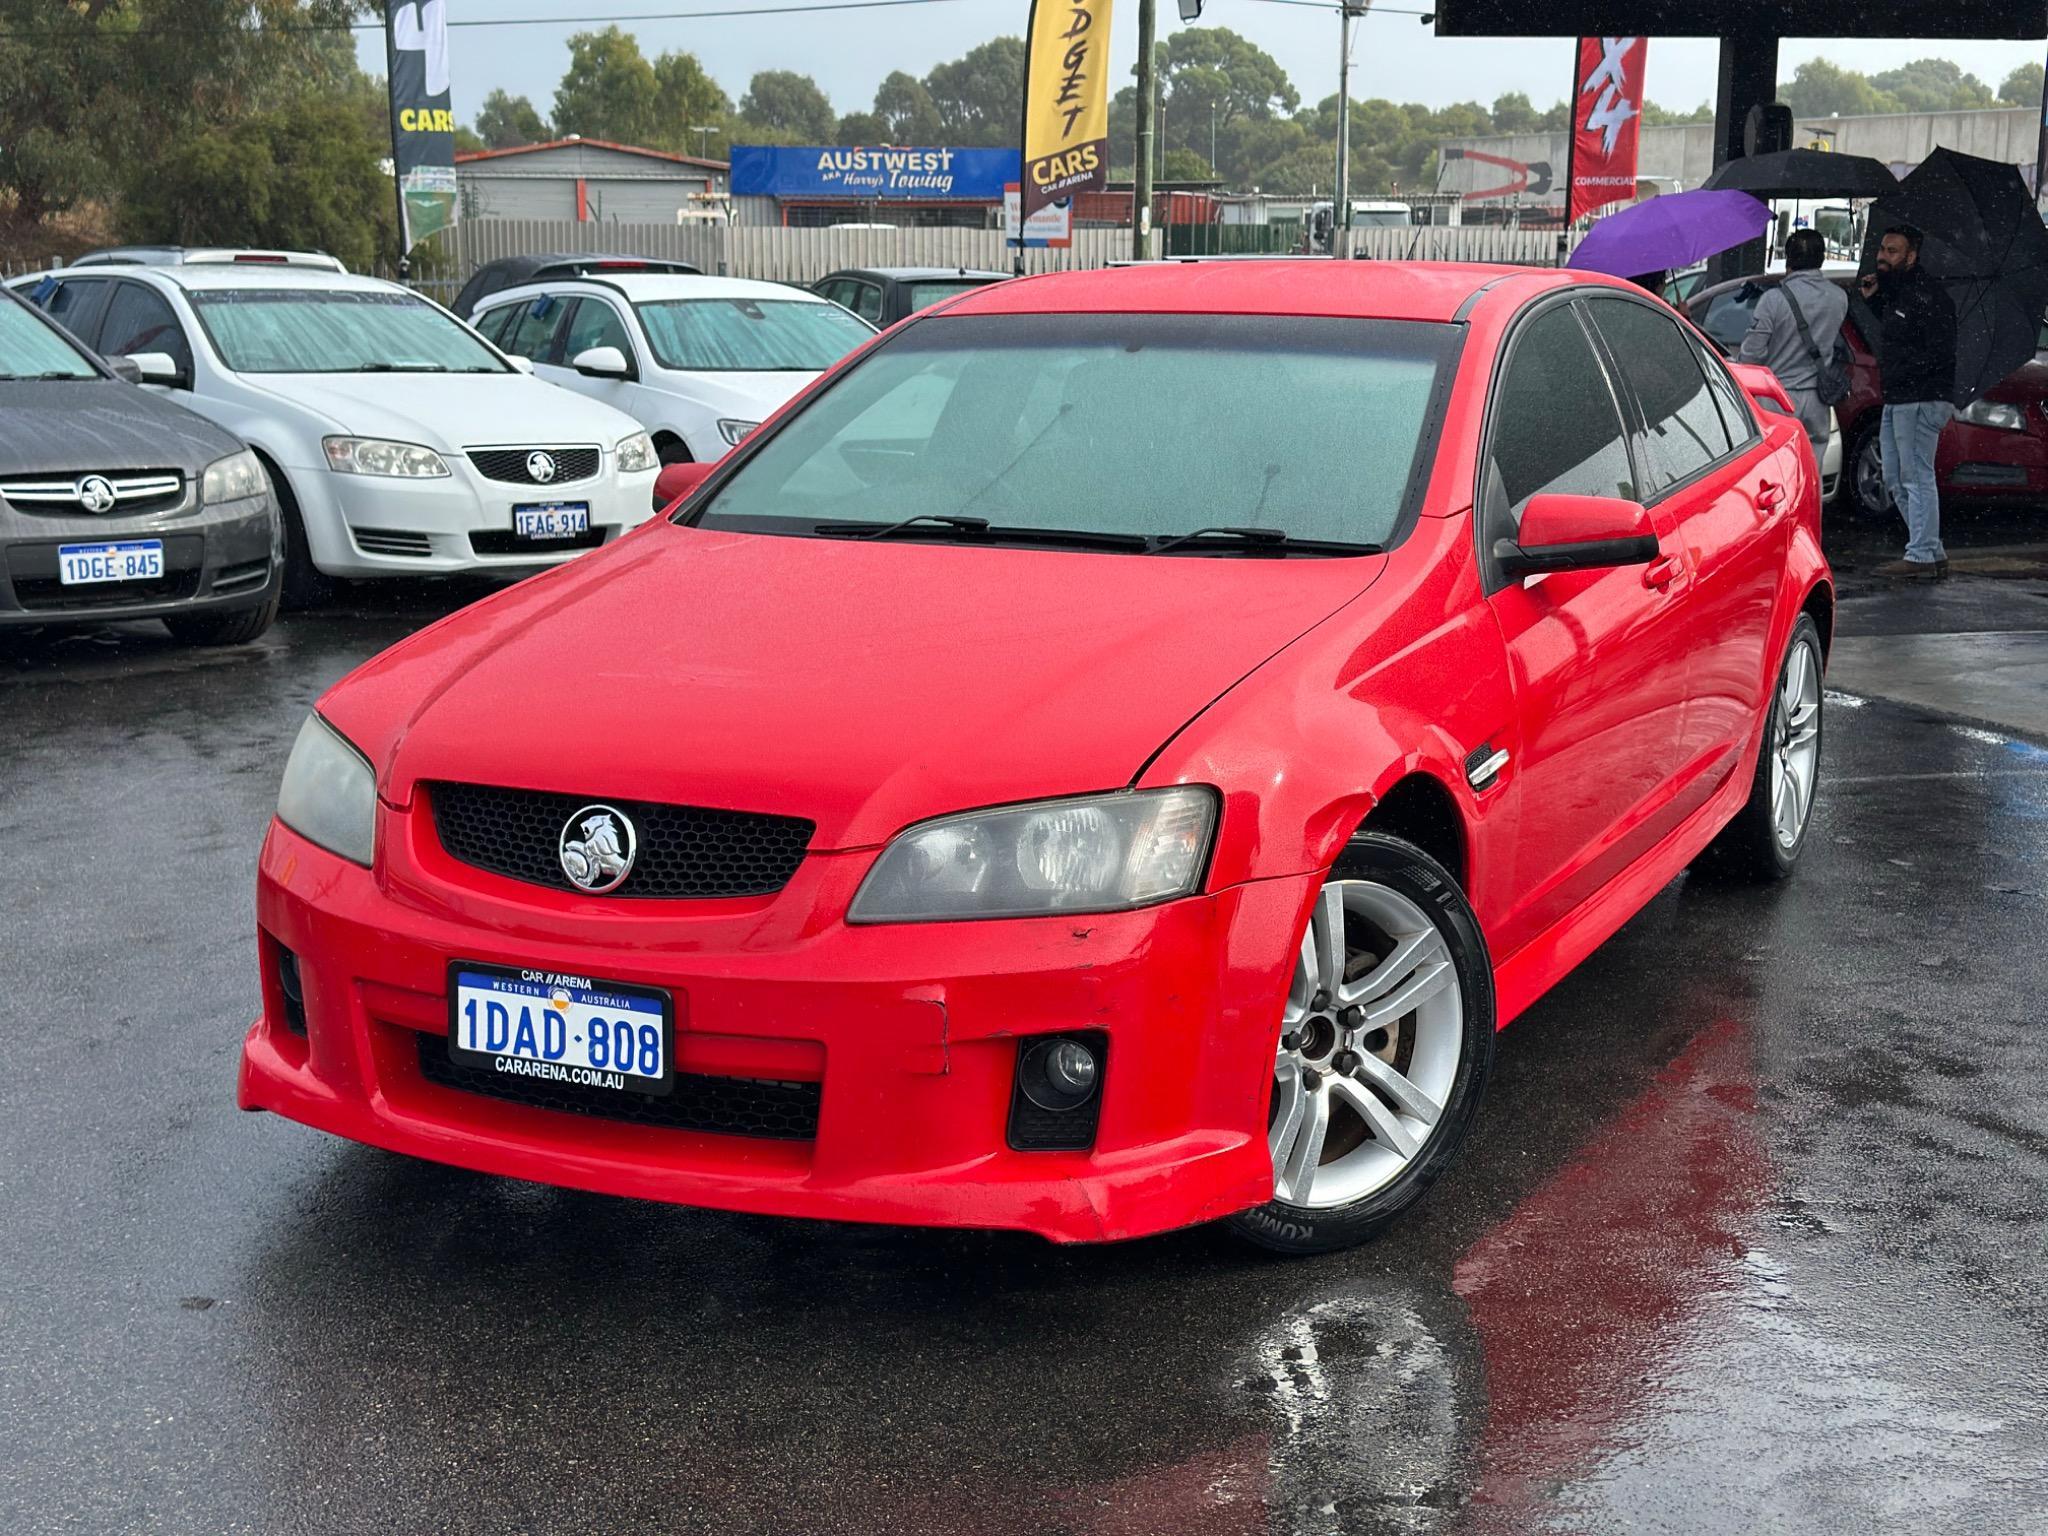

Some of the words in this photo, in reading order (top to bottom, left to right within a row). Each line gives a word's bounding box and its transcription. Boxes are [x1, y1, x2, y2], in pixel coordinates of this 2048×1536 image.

[1053, 0, 1092, 140] DGET
[817, 148, 954, 171] AUSTWEST
[1032, 145, 1099, 185] CARS
[889, 169, 953, 193] Towing
[521, 969, 544, 984] CAR
[492, 981, 540, 996] WESTERN
[581, 994, 631, 1010] AUSTRALIA
[495, 1056, 624, 1090] CARARENA.COM.AU
[1244, 1207, 1314, 1241] KUMH
